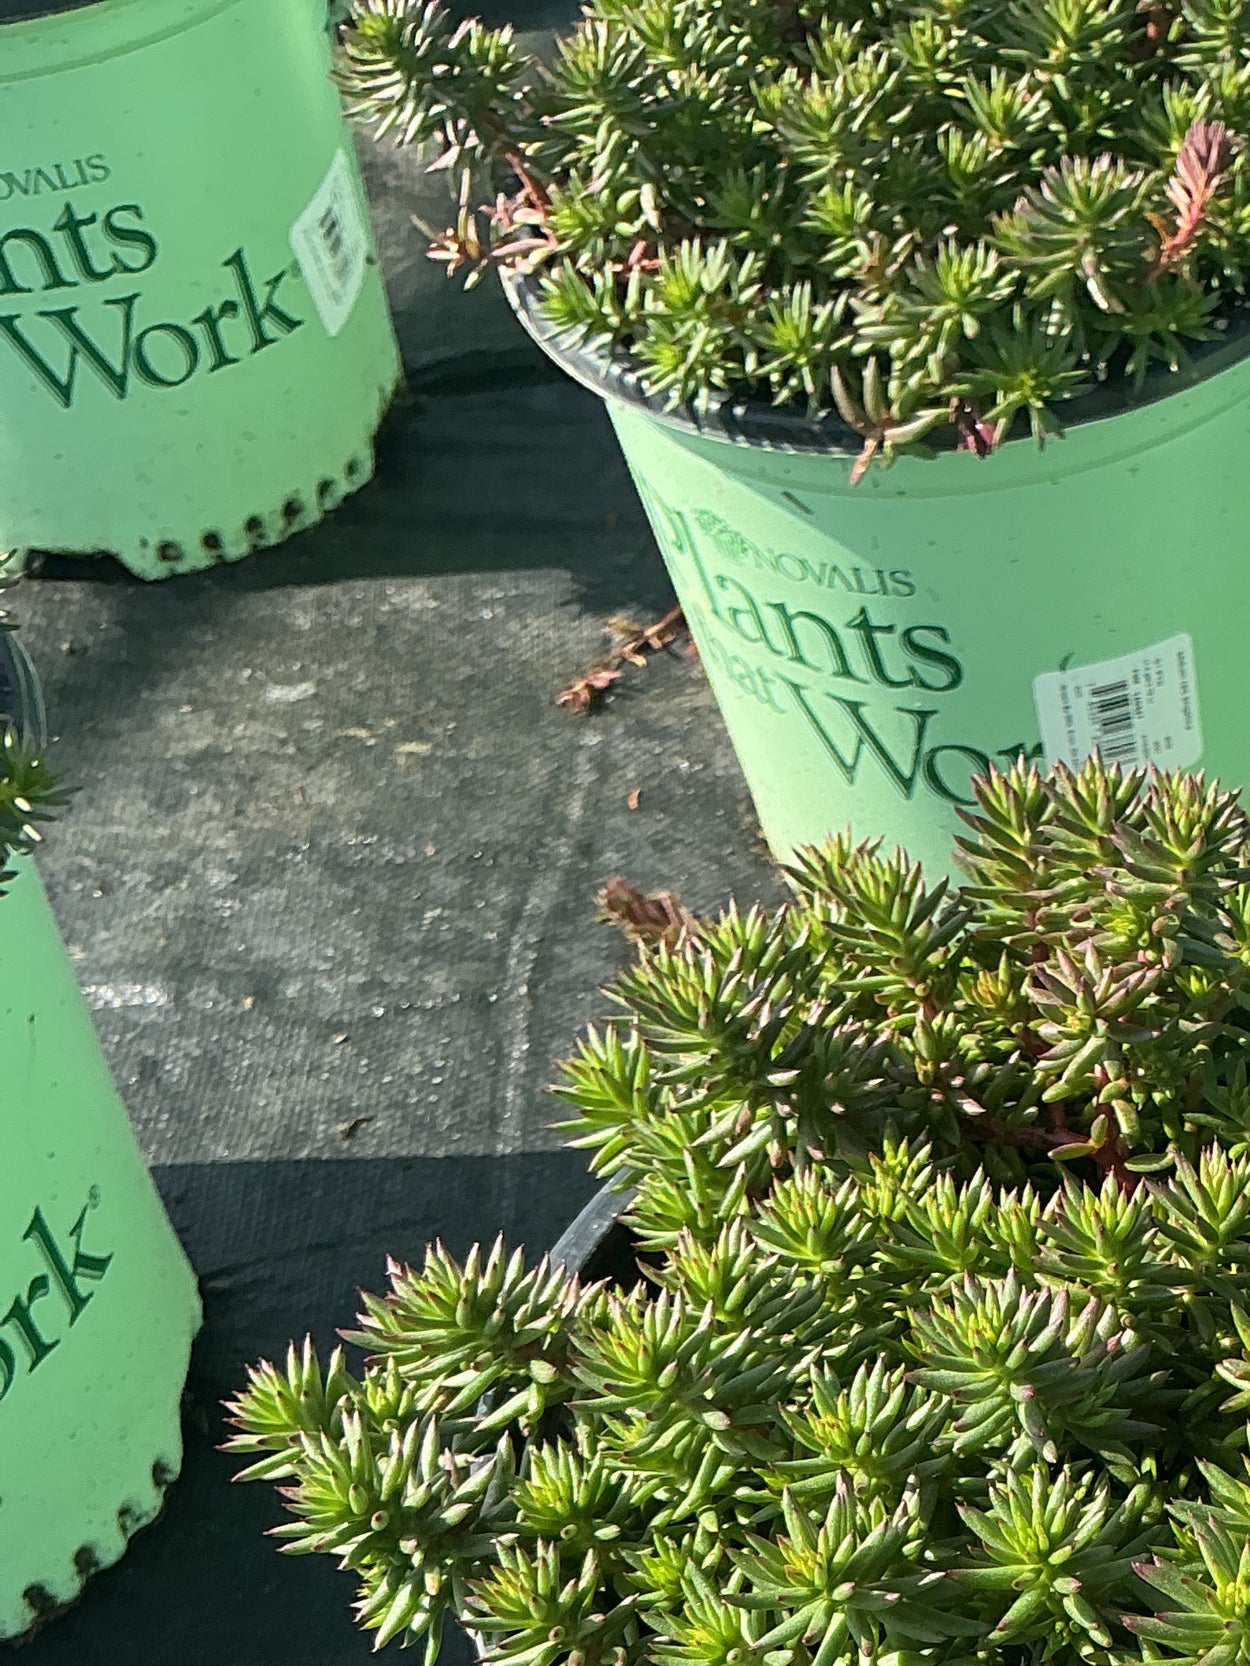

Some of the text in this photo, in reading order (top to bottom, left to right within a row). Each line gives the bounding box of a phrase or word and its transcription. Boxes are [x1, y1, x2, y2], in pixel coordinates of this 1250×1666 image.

[0, 202, 158, 294] nts
[0, 247, 304, 408] Work
[748, 541, 917, 598] NOVALIS
